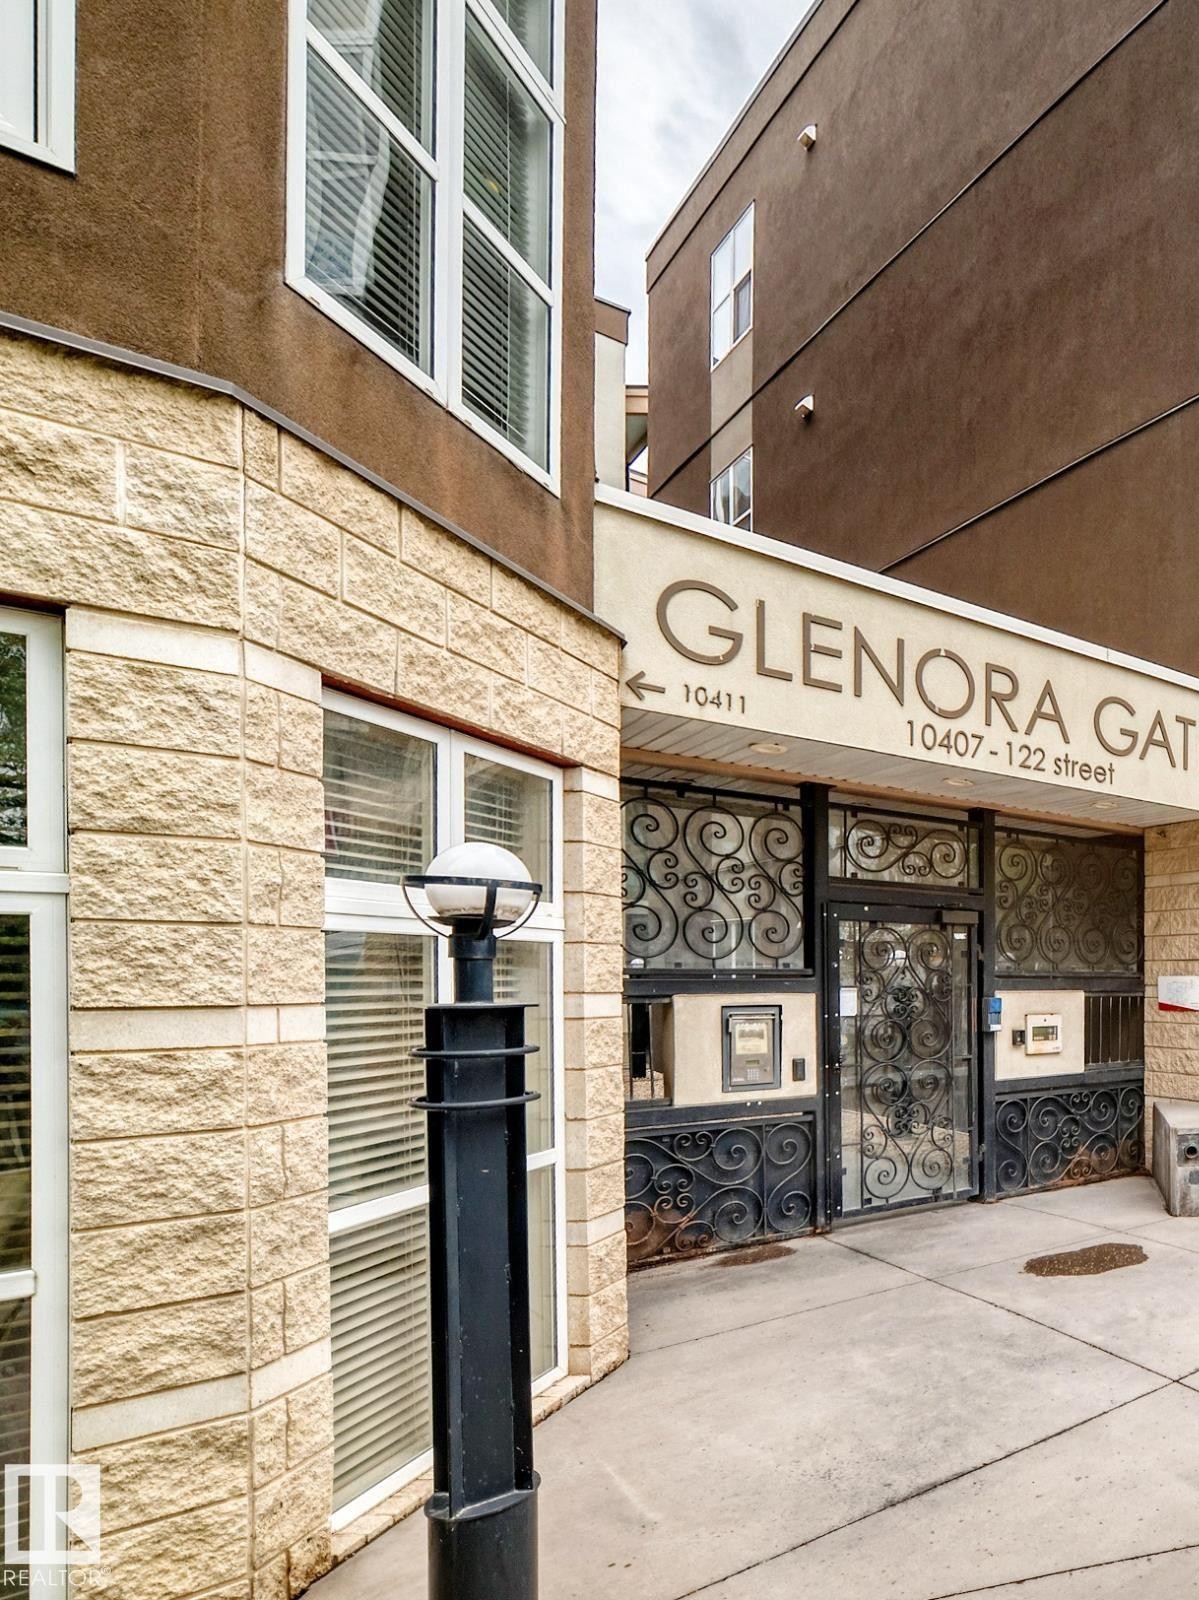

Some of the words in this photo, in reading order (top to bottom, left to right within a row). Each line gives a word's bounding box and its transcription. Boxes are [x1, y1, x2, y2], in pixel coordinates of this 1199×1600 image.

[656, 579, 1072, 744] GLENORA
[684, 684, 746, 714] 10411
[1053, 753, 1116, 785] street
